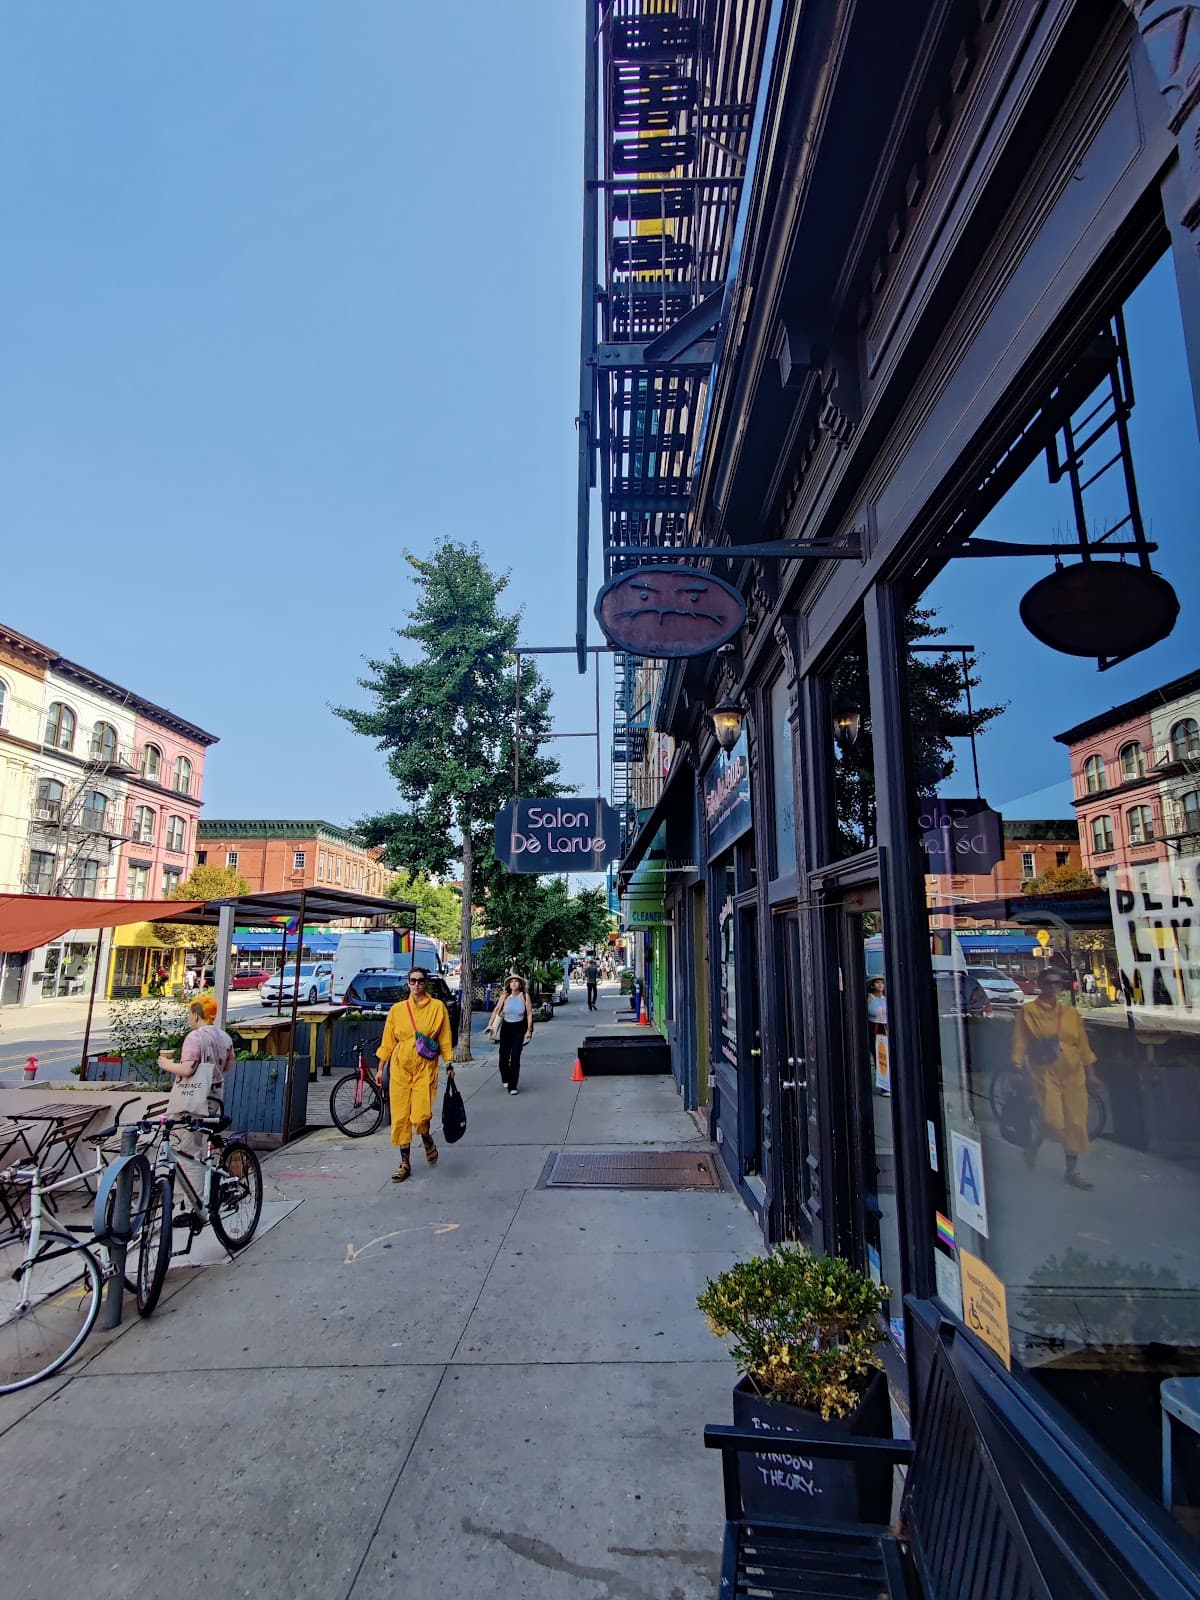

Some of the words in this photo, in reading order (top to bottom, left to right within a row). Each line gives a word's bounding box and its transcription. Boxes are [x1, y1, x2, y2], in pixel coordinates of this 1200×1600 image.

[527, 807, 589, 828] Salon
[547, 832, 606, 853] Larue
[959, 1146, 981, 1206] A
